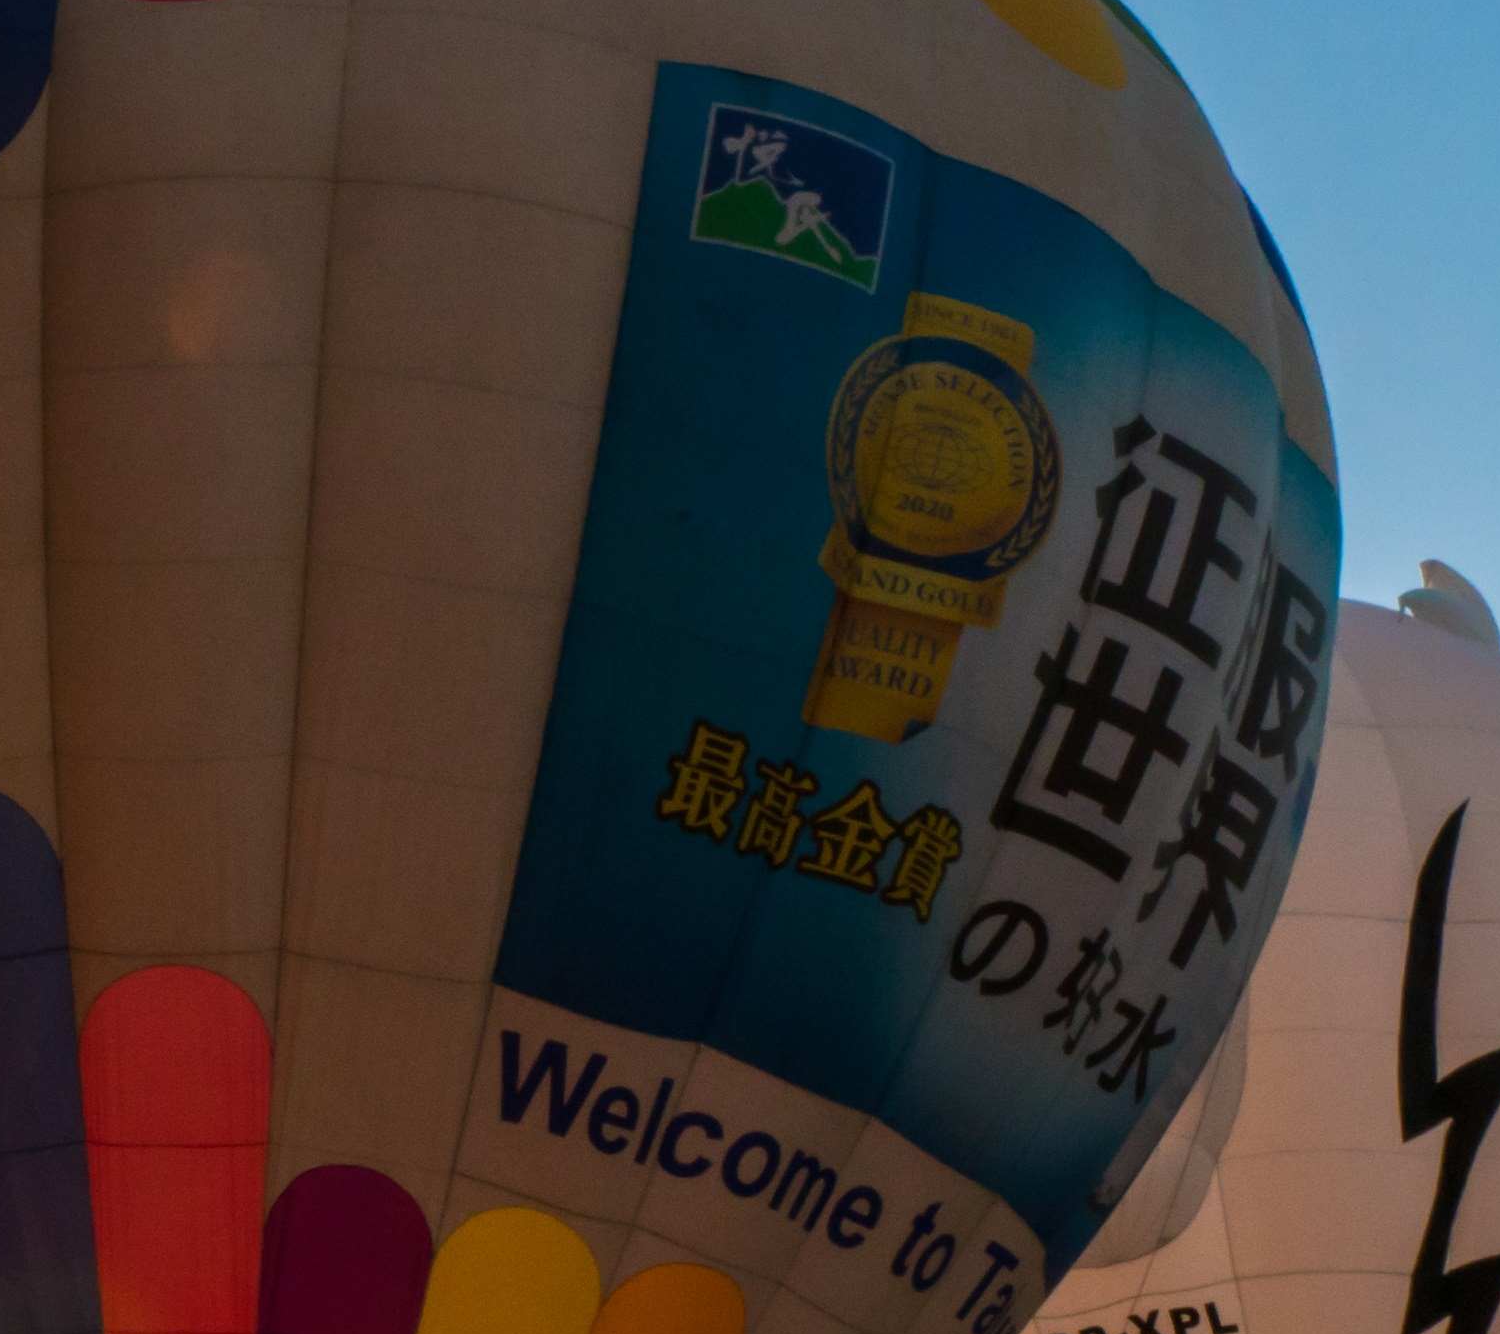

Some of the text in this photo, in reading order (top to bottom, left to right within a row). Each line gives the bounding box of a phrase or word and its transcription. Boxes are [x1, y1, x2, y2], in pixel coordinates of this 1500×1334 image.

[656, 720, 961, 924] 最高金賞
[500, 1030, 884, 1249] Welcome
[891, 1201, 956, 1292] to
